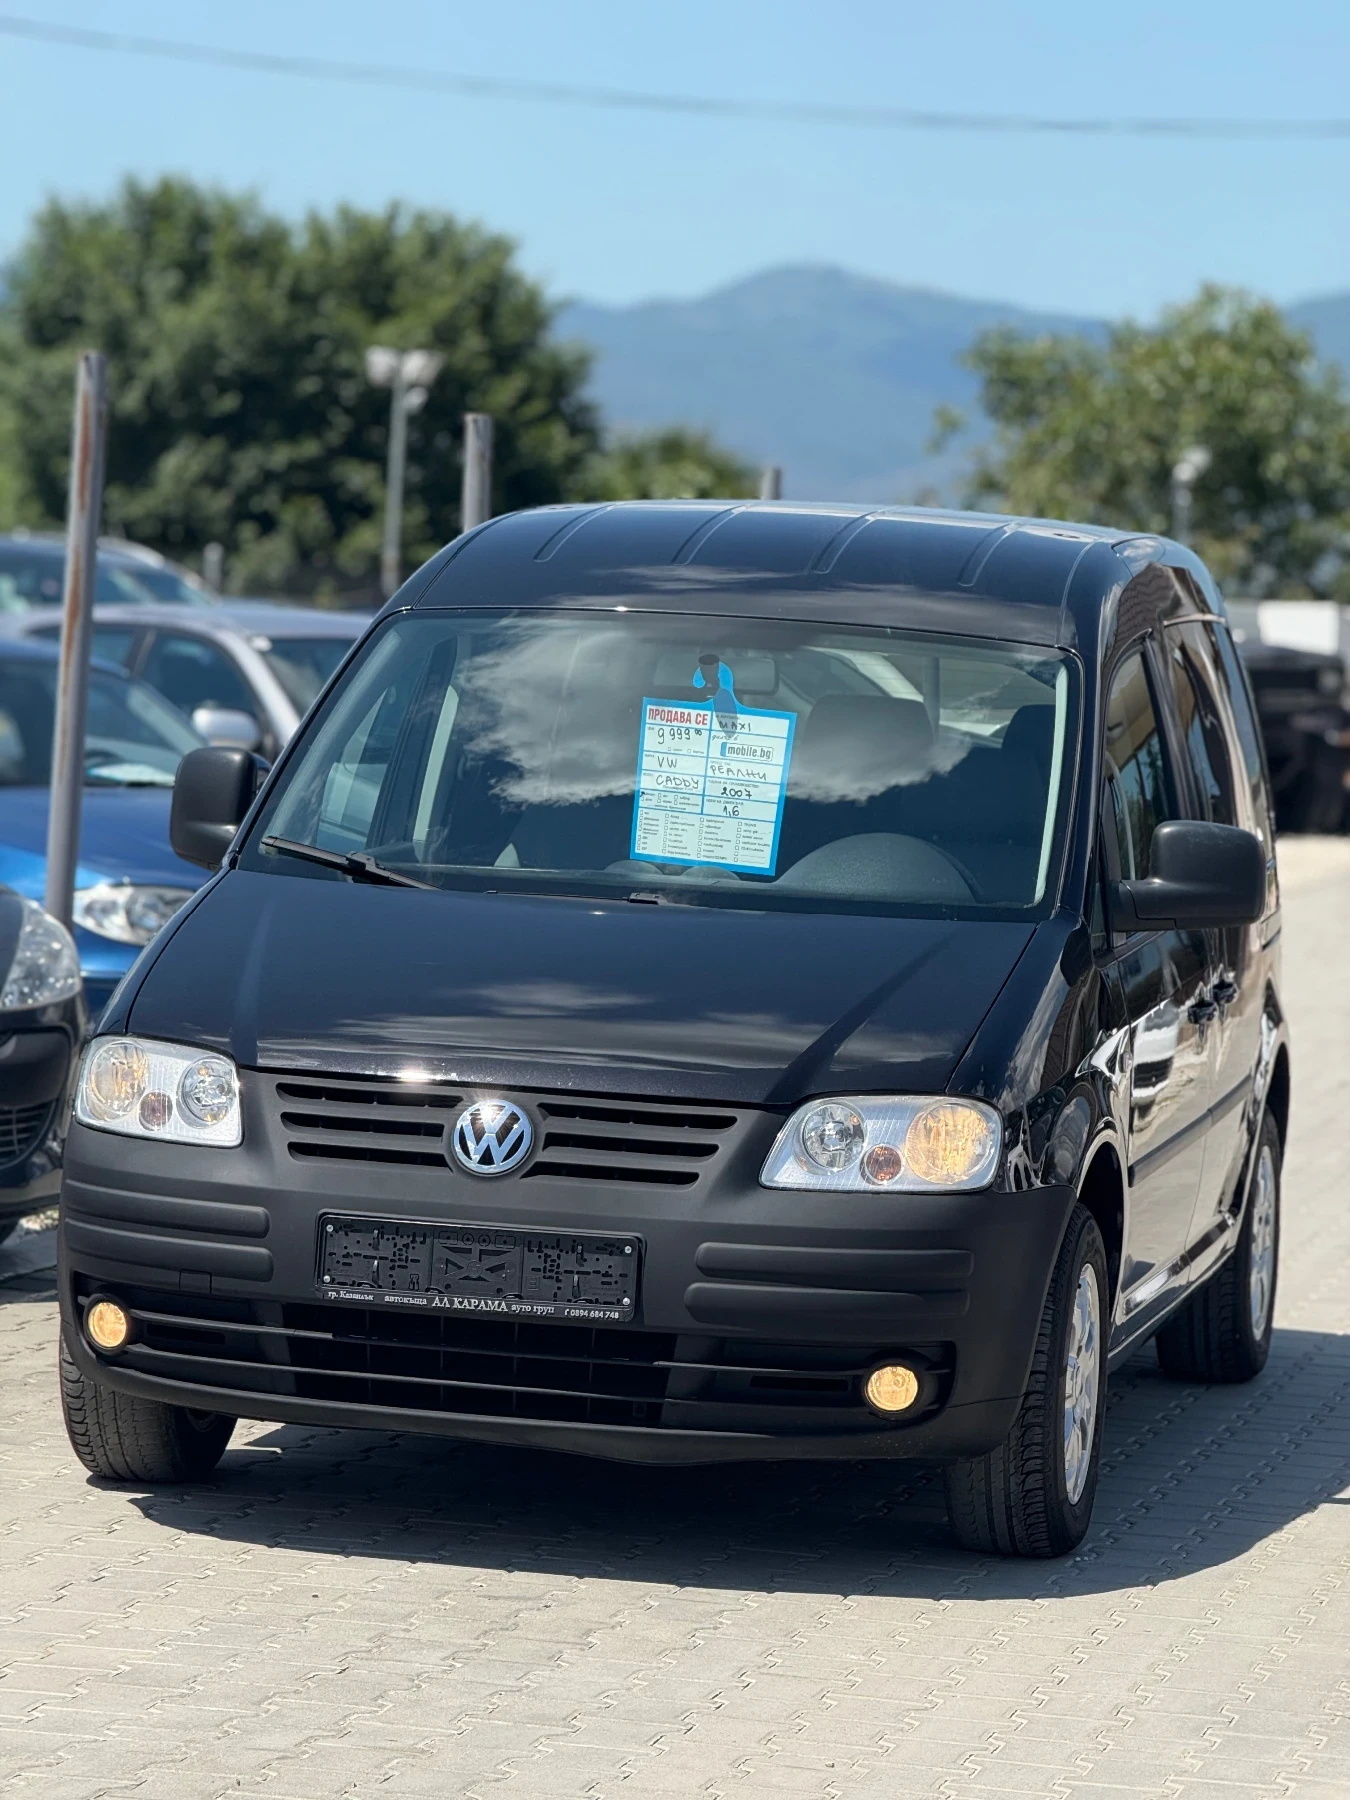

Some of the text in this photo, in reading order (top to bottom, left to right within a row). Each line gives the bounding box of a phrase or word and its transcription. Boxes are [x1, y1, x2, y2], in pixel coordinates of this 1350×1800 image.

[648, 707, 692, 724] ПРОДАВА
[695, 712, 709, 726] СЕ
[727, 745, 772, 760] mobile.bg
[657, 755, 678, 768] VW
[656, 774, 699, 790] CADDY
[721, 786, 753, 800] 2007
[723, 805, 740, 818] 1,6
[453, 1297, 508, 1313] КАРАМА
[511, 1304, 532, 1314] ауто
[533, 1305, 555, 1315] груп
